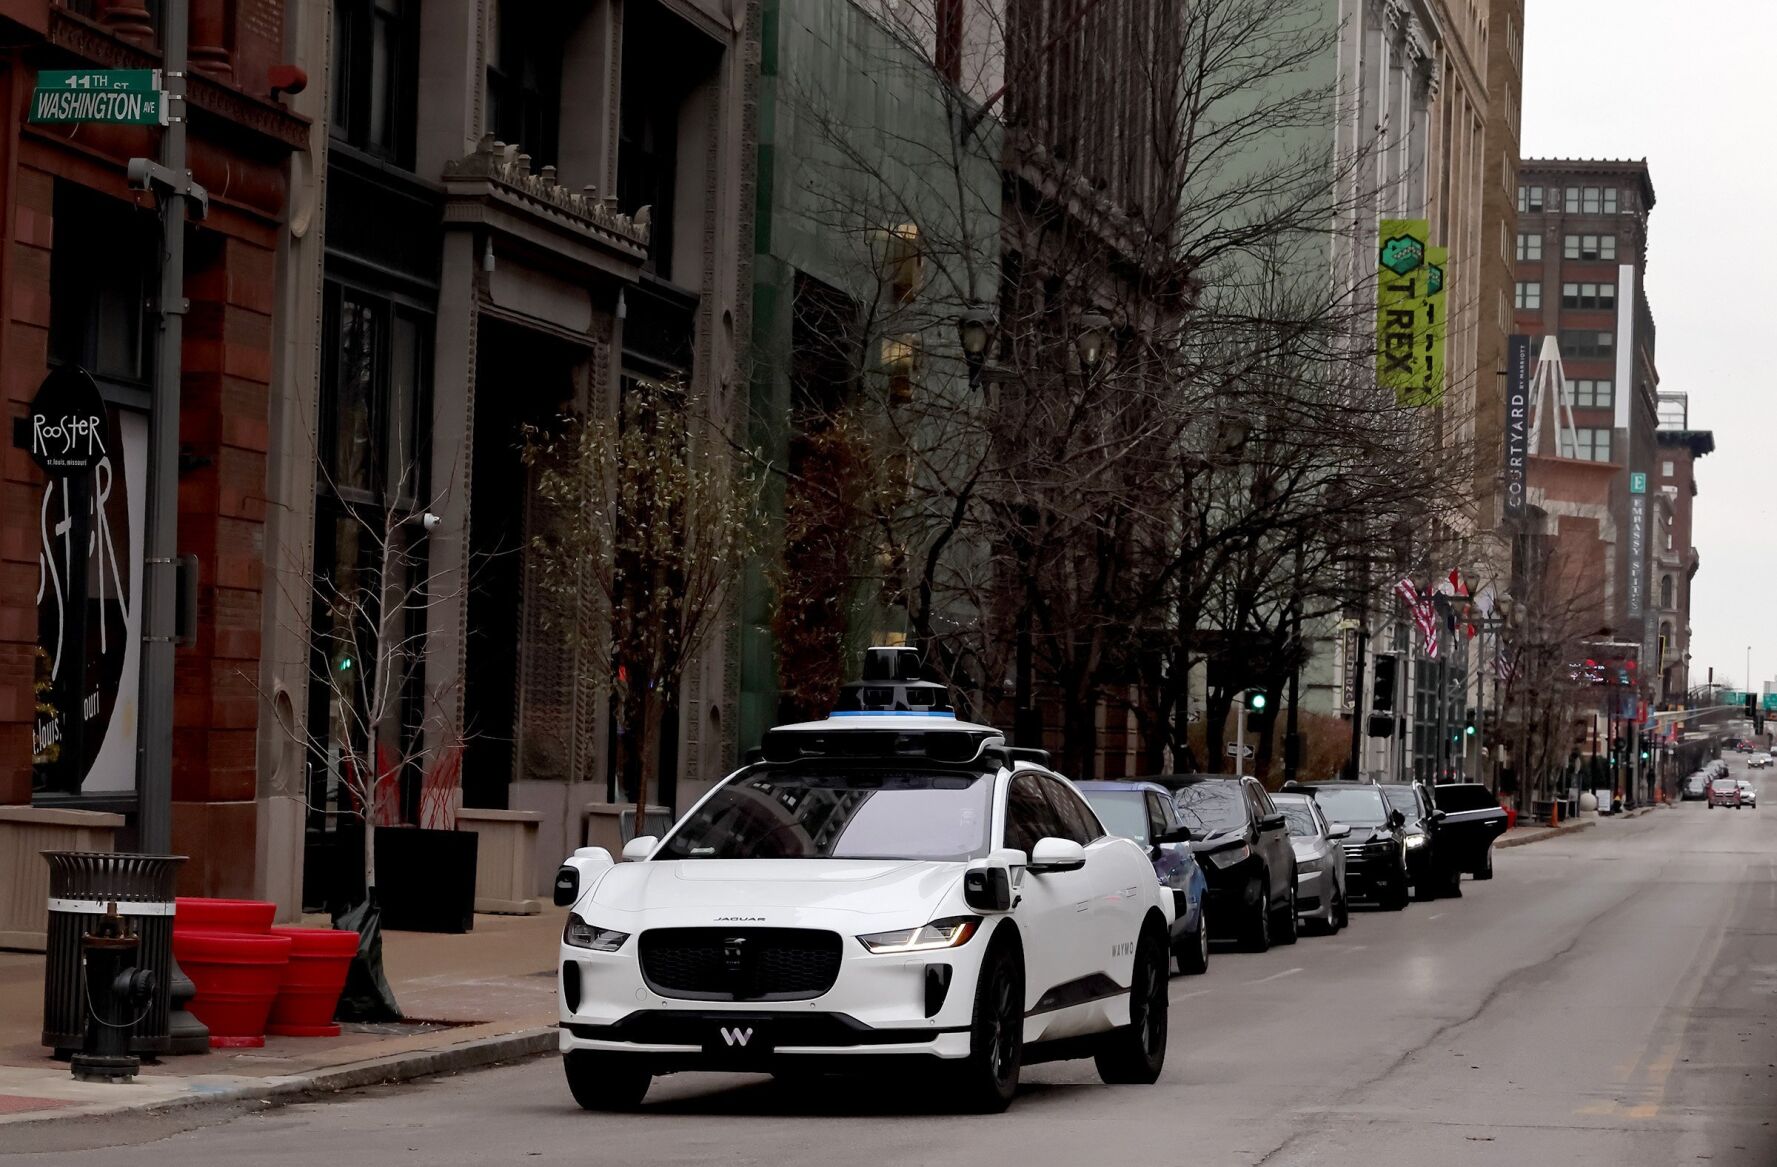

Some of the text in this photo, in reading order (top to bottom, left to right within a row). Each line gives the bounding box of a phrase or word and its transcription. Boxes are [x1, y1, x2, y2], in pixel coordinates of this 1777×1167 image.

[37, 92, 155, 120] WASHINGTON AVE
[1509, 394, 1524, 508] COURTYARD
[1632, 499, 1643, 555] EMBASSY
[1111, 942, 1134, 957] WAYMO
